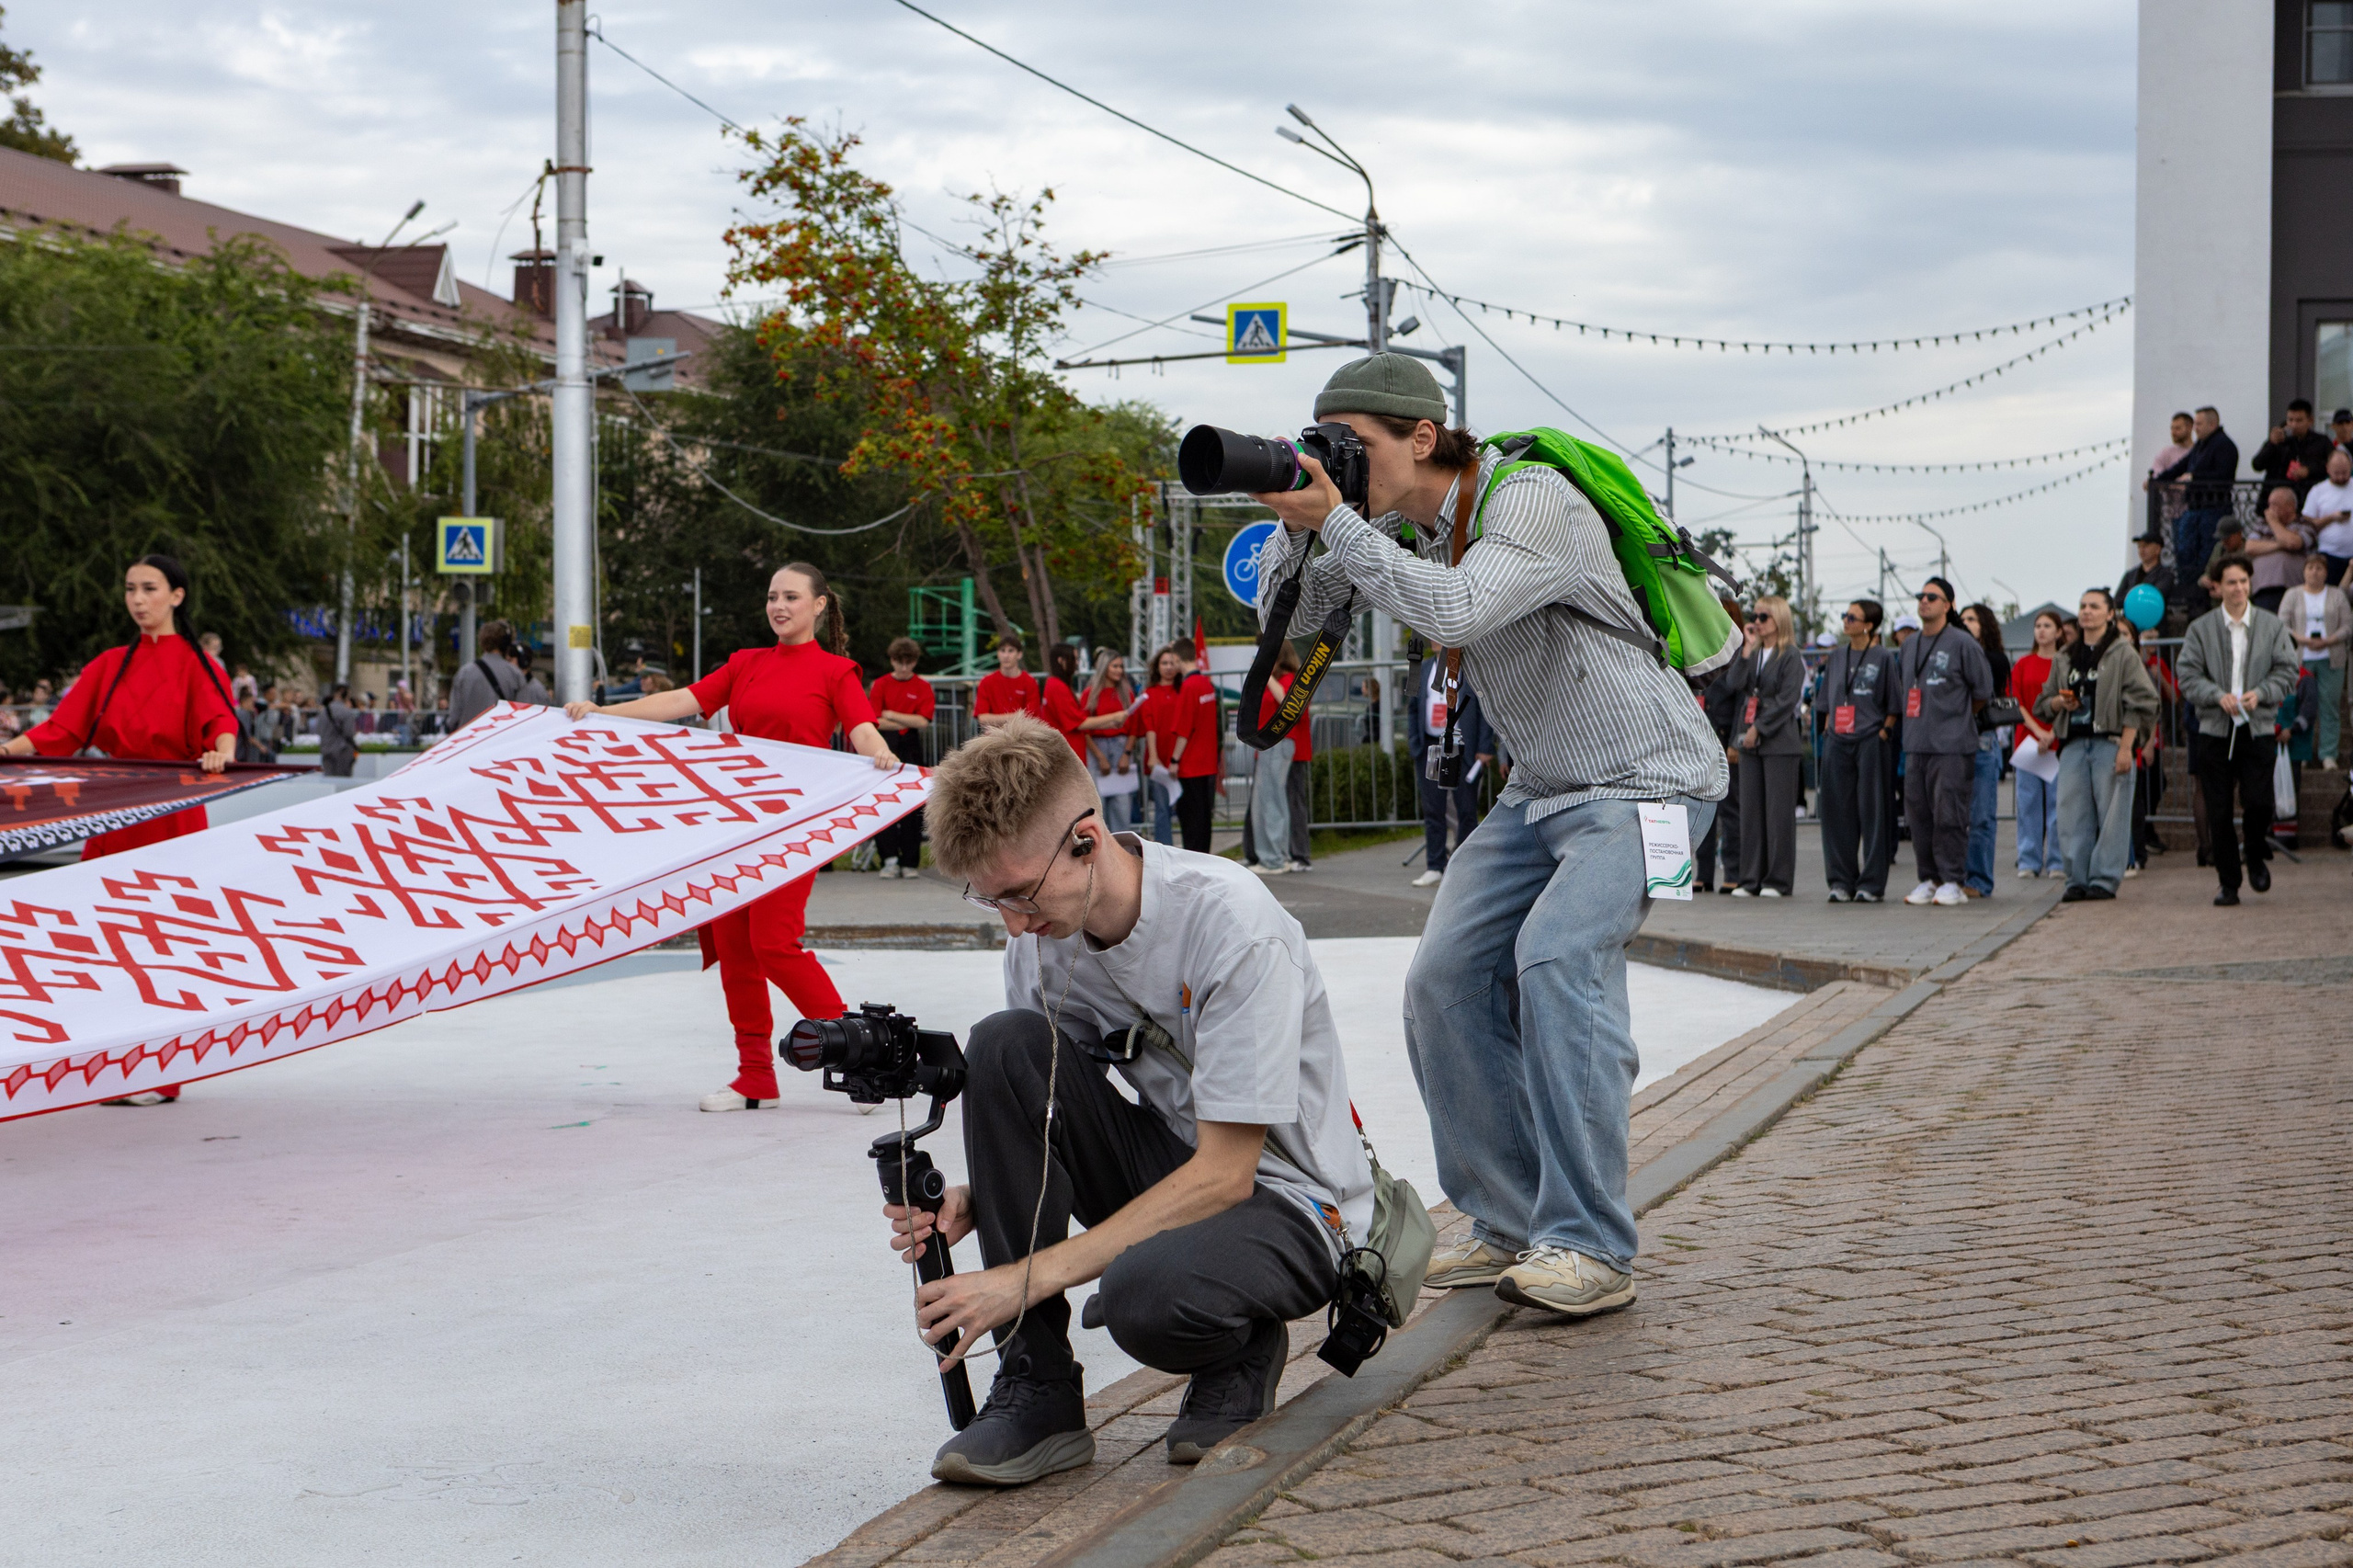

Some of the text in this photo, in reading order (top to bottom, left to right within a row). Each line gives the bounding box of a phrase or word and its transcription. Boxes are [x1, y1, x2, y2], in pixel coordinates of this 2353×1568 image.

[1272, 642, 1331, 733] Nikon D700 FX
